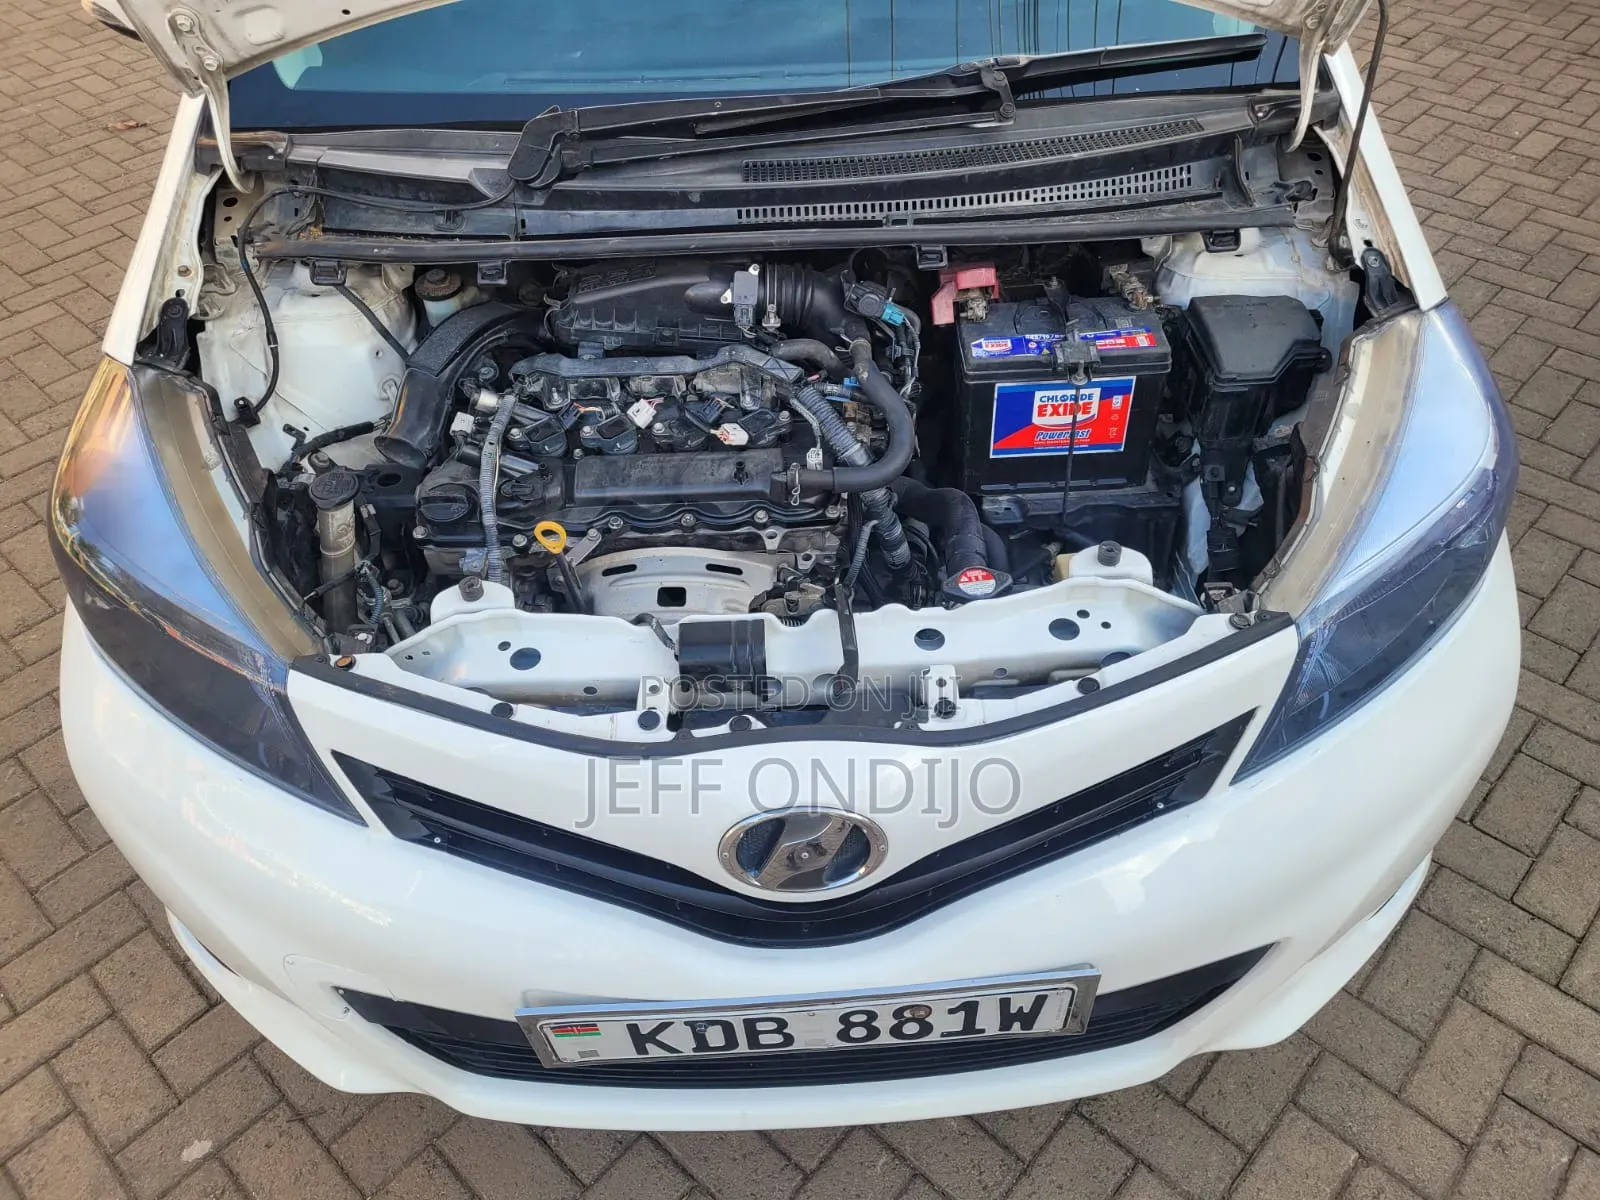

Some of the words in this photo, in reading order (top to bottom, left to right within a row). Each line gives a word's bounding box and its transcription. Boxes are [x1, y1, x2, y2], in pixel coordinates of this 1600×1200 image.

[1039, 392, 1094, 403] CHLORDE
[1035, 429, 1091, 441] Powerast
[625, 1016, 796, 1056] KDB
[836, 994, 1049, 1044] 881W
